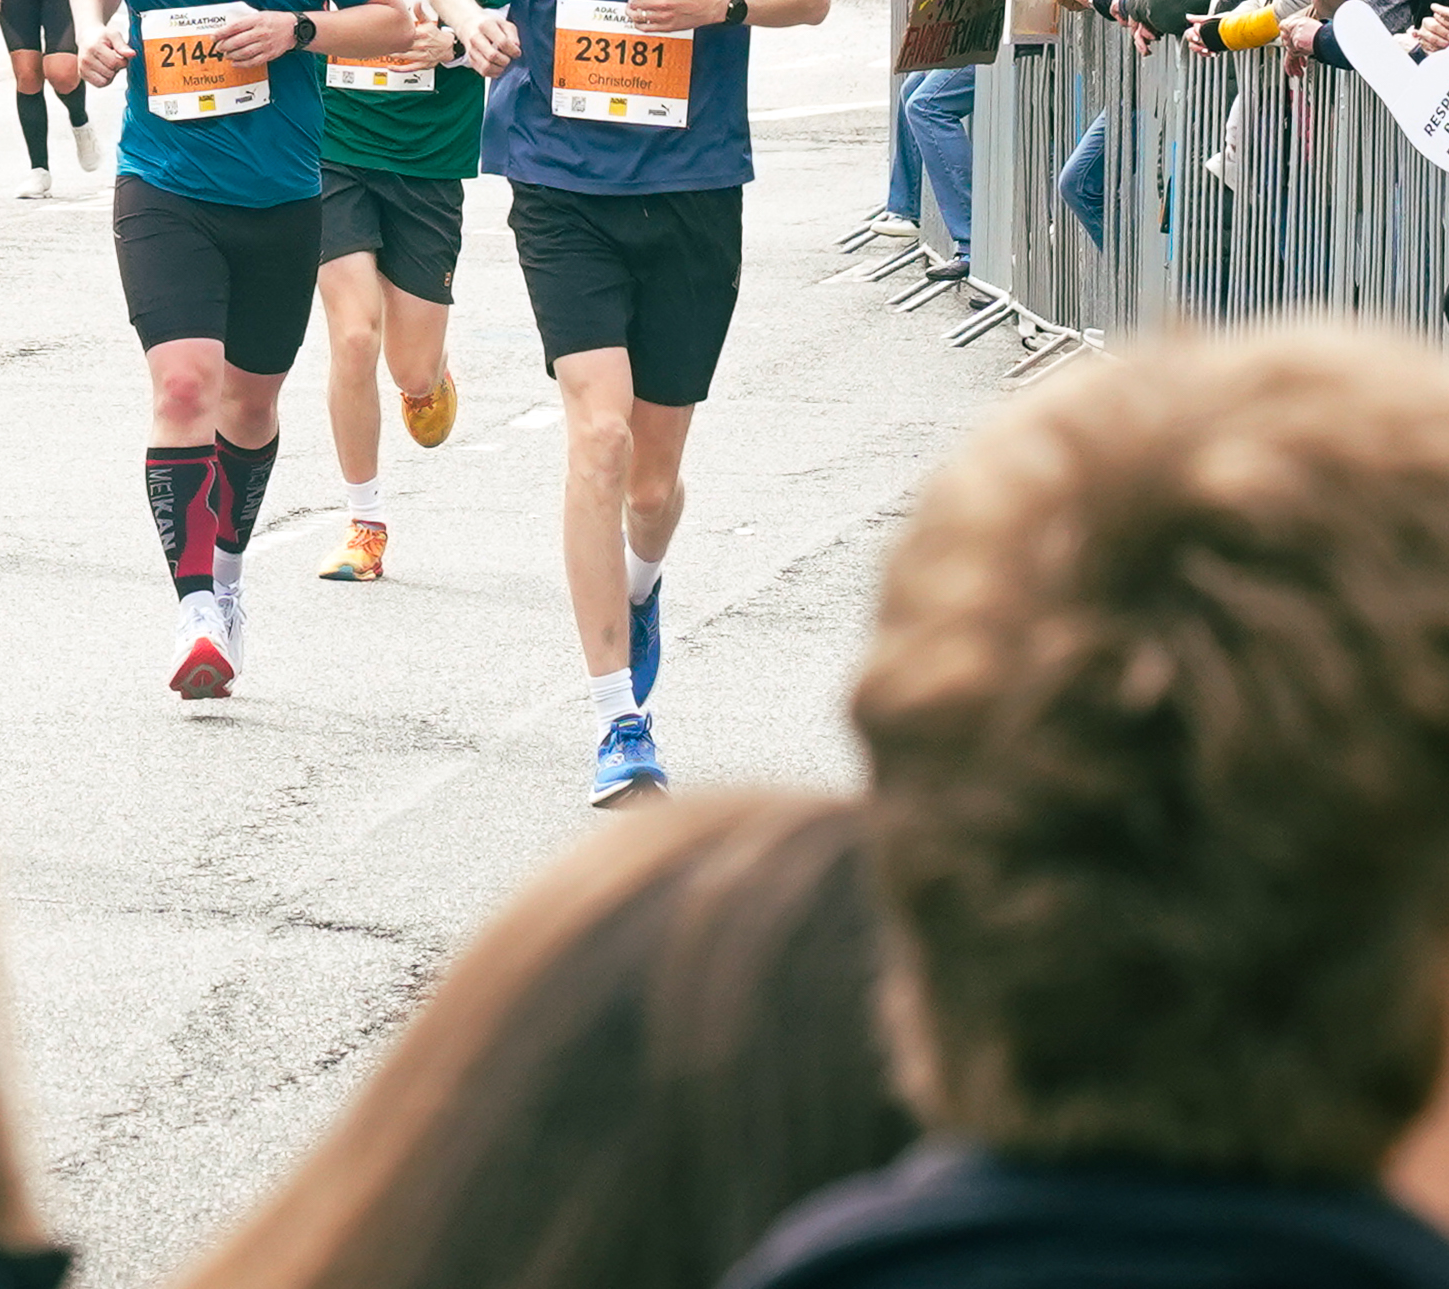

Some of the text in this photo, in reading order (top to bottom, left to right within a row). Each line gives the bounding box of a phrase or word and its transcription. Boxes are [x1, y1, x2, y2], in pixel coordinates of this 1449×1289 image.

[594, 6, 618, 15] ADAC
[178, 15, 226, 27] MARATHON
[160, 40, 225, 69] 2144
[575, 36, 664, 68] 23181
[183, 74, 225, 87] Markus
[588, 73, 653, 91] Christoffer
[148, 468, 177, 552] MEIKAN
